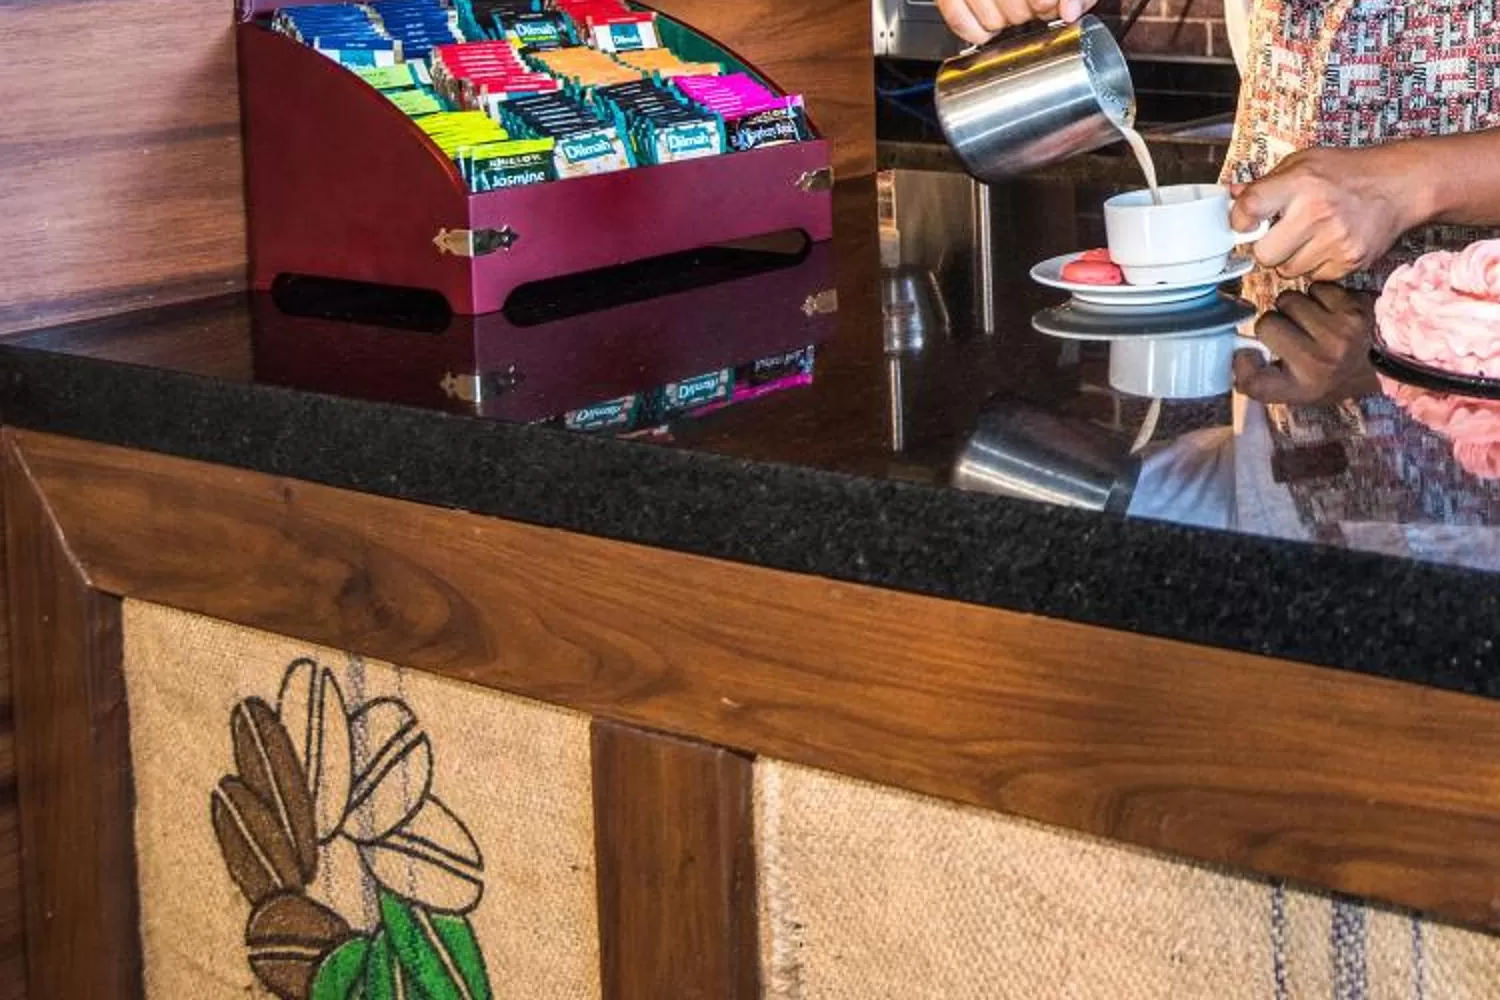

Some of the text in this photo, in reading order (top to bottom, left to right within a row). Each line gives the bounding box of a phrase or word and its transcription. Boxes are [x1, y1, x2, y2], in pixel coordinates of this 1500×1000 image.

[514, 22, 557, 37] Dilmah
[564, 139, 611, 159] Dilmah
[668, 133, 709, 149] Dilmah
[492, 171, 545, 188] Jasmine
